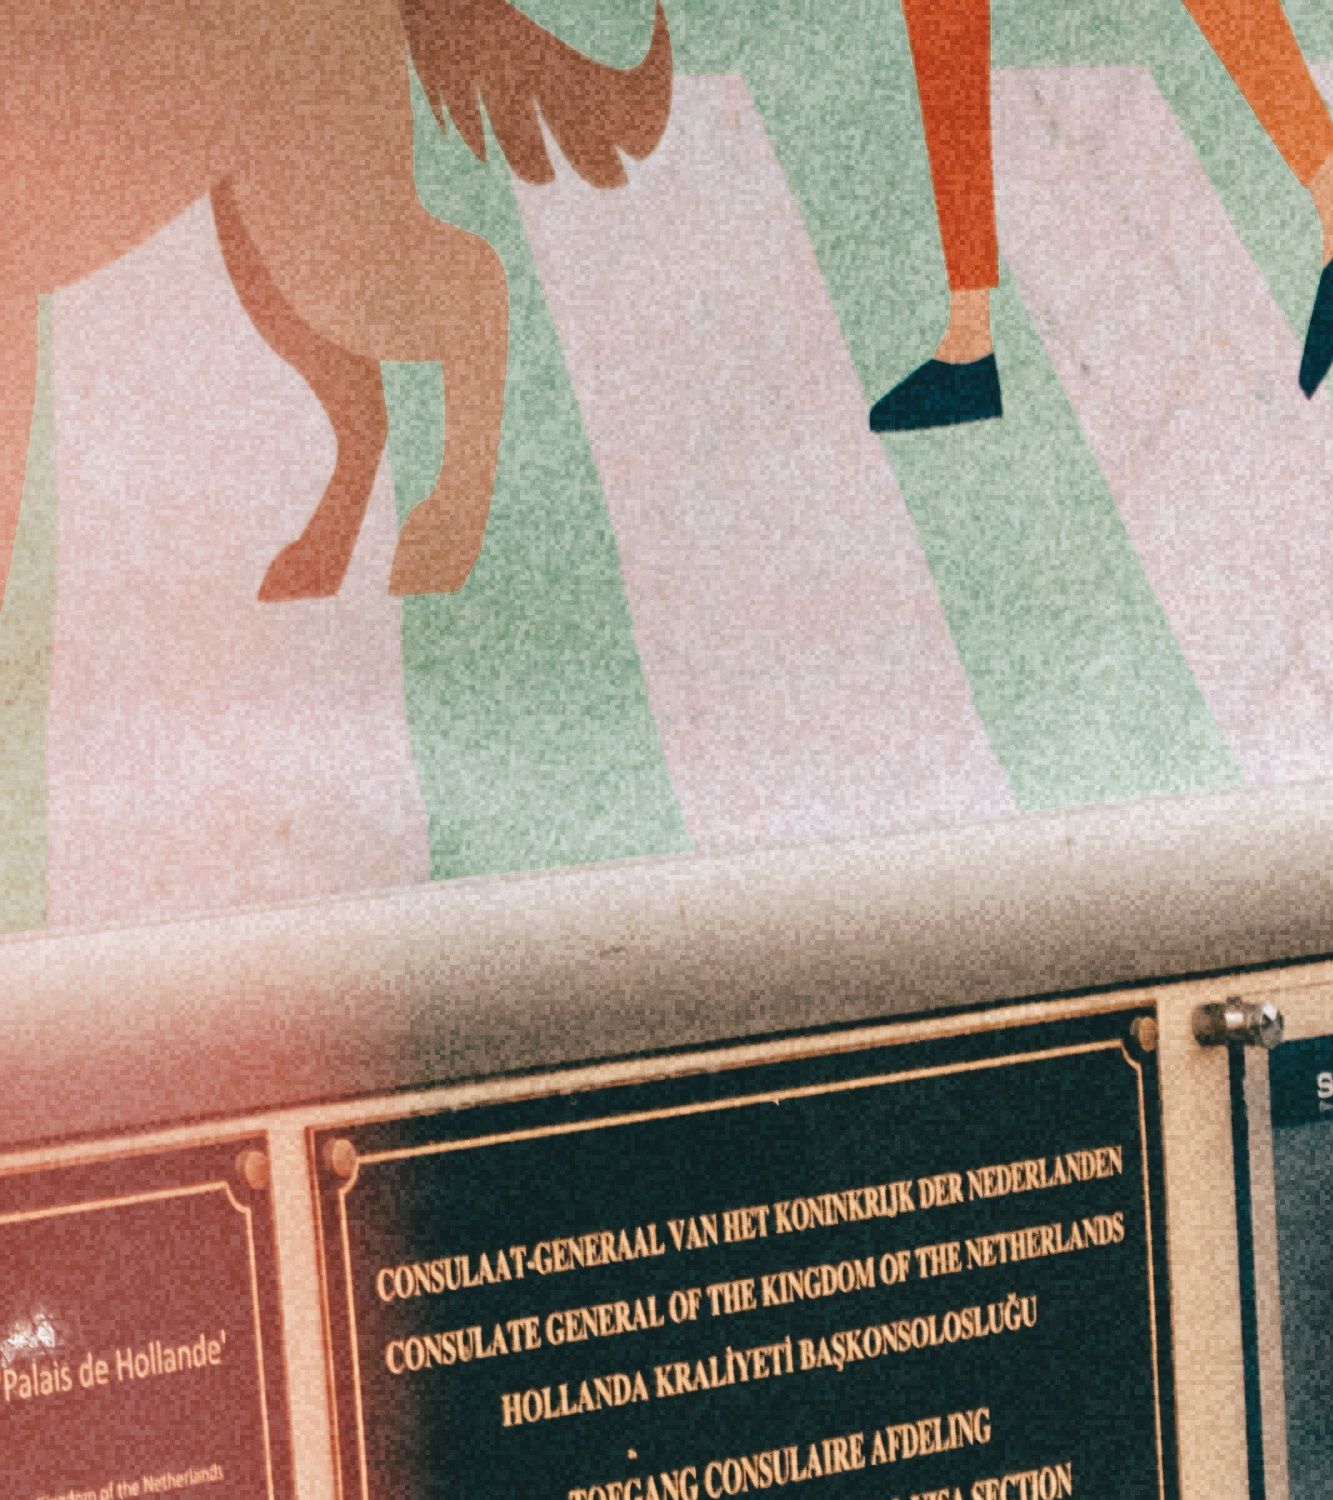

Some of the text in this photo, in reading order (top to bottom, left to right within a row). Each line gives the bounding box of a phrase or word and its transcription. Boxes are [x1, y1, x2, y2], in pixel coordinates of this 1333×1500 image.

[376, 1144, 1124, 1303] CONSULAAT-GENERAAL VAN HET KONINKRIJK DER NEDERLANDEN
[385, 1210, 1126, 1376] CONSULATE GENERAL OF THE KINGDOM OF THE NETHERLANDS
[3, 1327, 227, 1402] Palais de Hollande'
[500, 1291, 1039, 1429] HOLLANDA KRALİYETİ BAŞKONSOLOSLUĞU
[117, 1478, 141, 1500] the
[144, 1462, 225, 1494] Netherlands
[704, 1431, 867, 1500] CONSULAIRE
[870, 1405, 993, 1466] AFDELING
